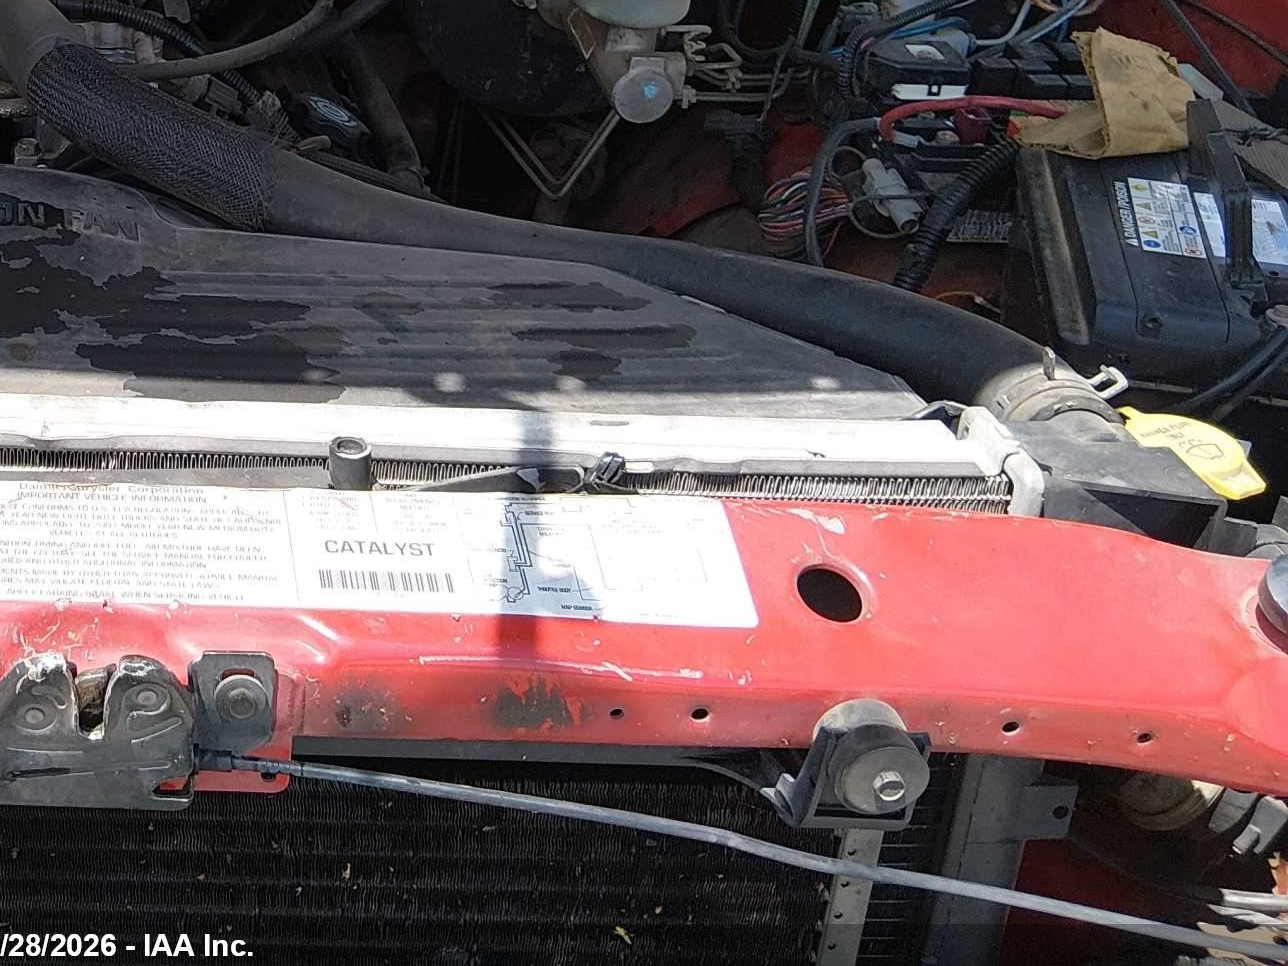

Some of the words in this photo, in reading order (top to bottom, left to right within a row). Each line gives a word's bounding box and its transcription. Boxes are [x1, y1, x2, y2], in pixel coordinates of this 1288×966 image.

[64, 208, 141, 242] FAN
[17, 491, 81, 501] IMPORTANT
[131, 495, 207, 504] INFORMATION
[128, 485, 204, 496] Corporation
[324, 539, 435, 557] CATALYST
